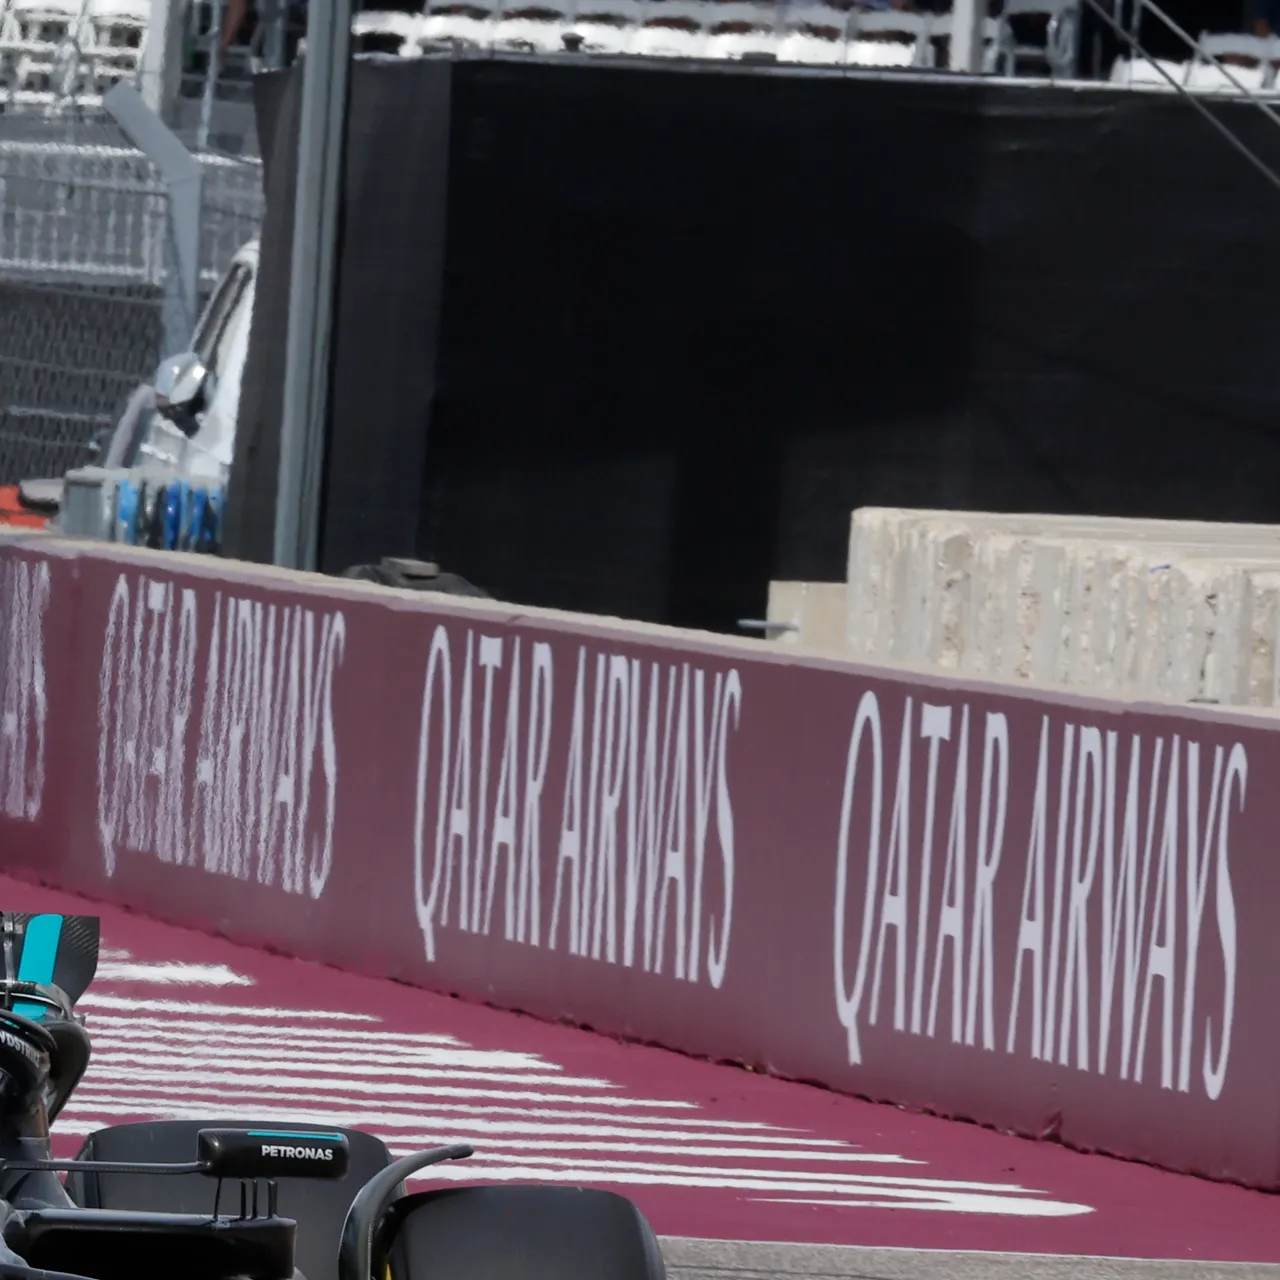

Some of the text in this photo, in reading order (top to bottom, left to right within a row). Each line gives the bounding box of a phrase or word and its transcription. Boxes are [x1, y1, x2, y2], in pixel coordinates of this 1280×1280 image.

[414, 625, 554, 962] QATAR
[548, 645, 742, 989] AIRWAYS
[834, 690, 1248, 1101] QATAR AIRWAYS
[261, 1145, 333, 1161] PETRONAS
